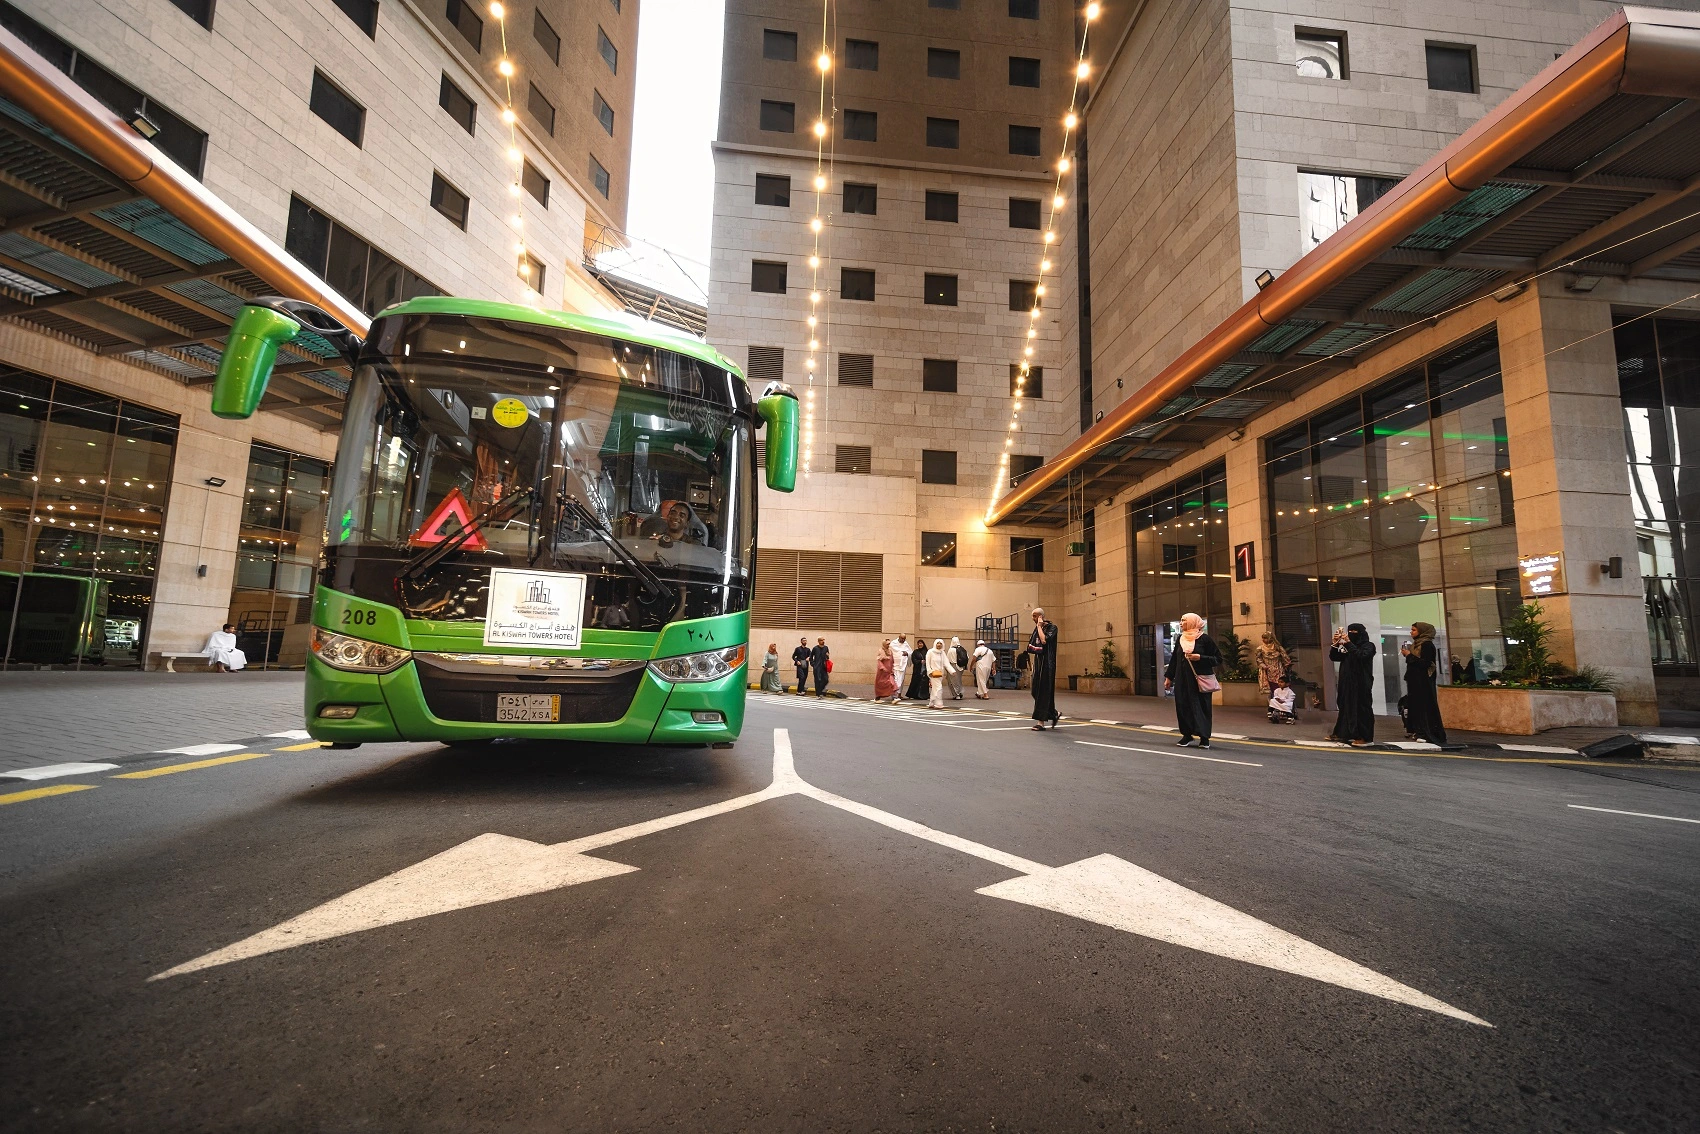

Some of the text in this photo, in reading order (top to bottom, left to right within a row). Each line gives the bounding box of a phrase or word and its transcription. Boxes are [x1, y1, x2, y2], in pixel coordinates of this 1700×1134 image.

[1237, 545, 1251, 577] 1
[342, 609, 376, 626] 208
[687, 629, 714, 642] ٢٠٨
[500, 709, 528, 720] 3542
